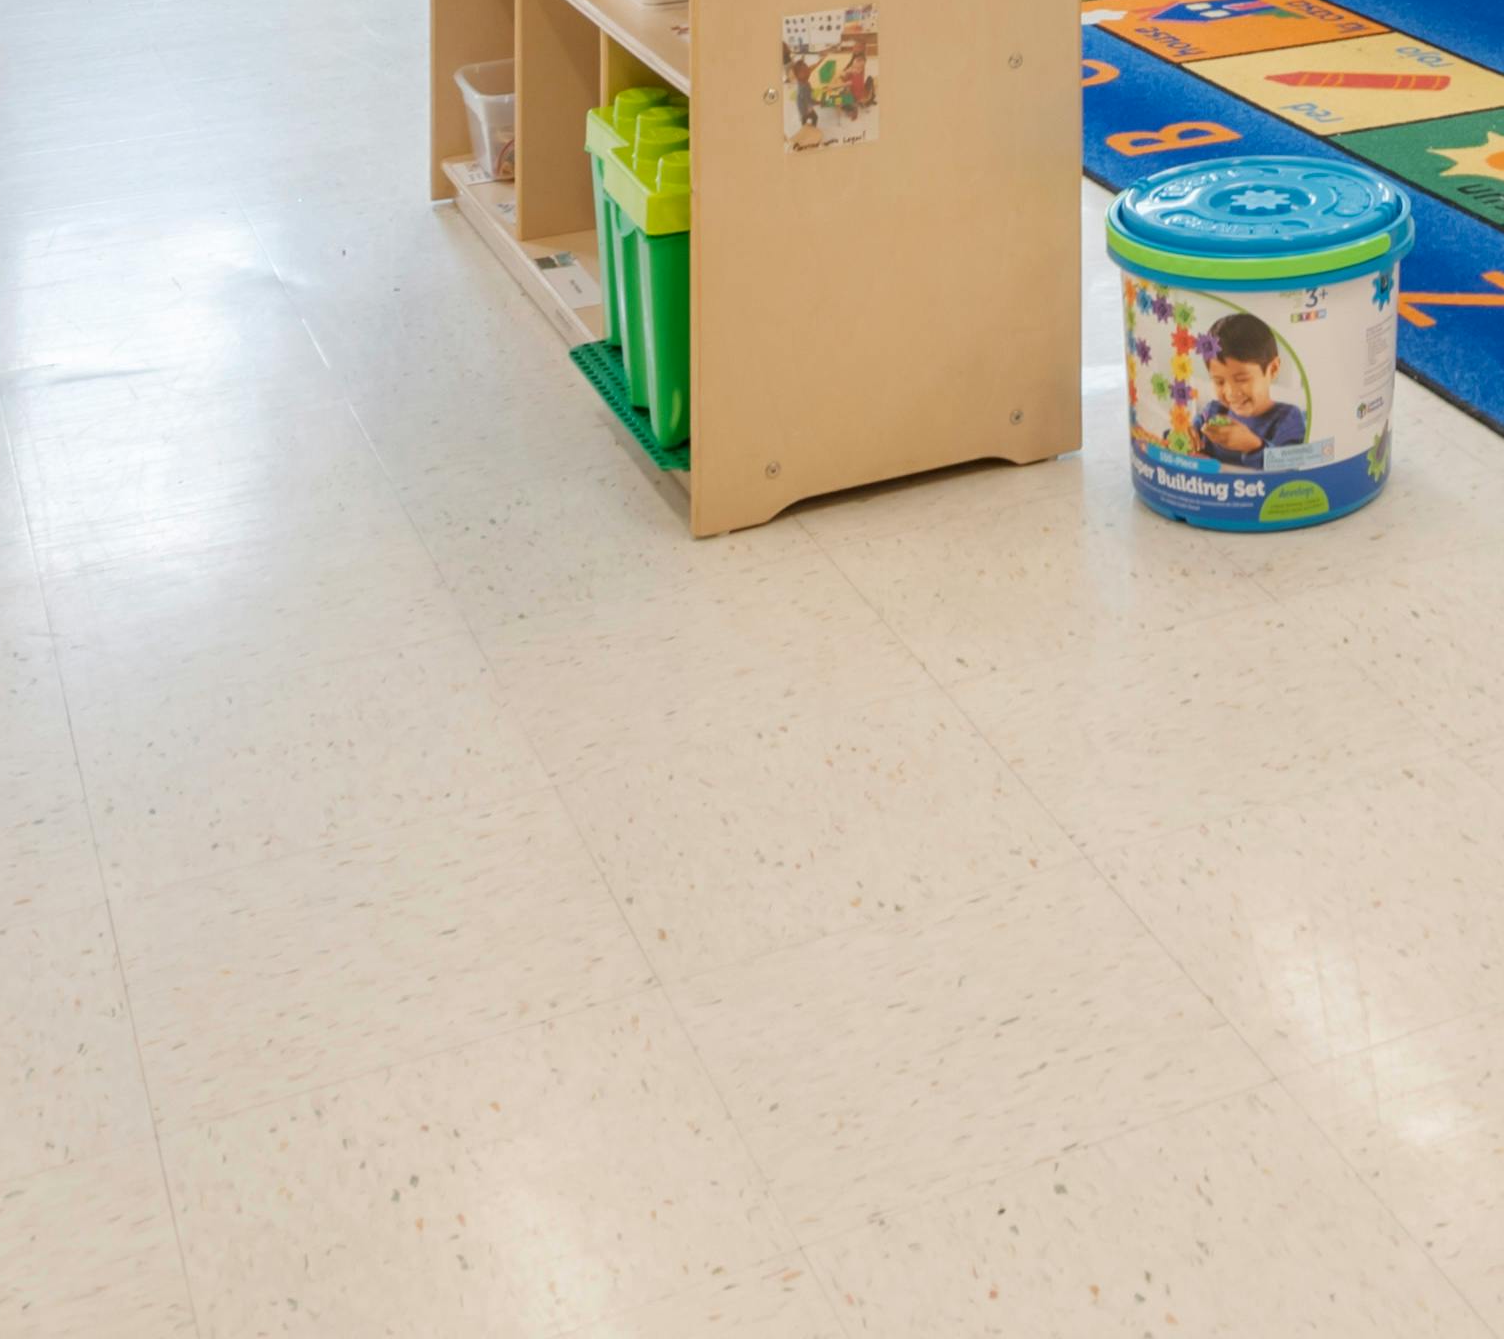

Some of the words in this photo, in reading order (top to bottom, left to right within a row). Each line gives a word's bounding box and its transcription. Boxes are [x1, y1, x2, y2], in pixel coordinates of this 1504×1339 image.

[1133, 26, 1207, 58] house
[1395, 45, 1454, 69] rojo
[1280, 102, 1345, 124] red
[1304, 287, 1329, 309] 3+
[1156, 466, 1229, 501] Building
[1233, 478, 1266, 498] Set
